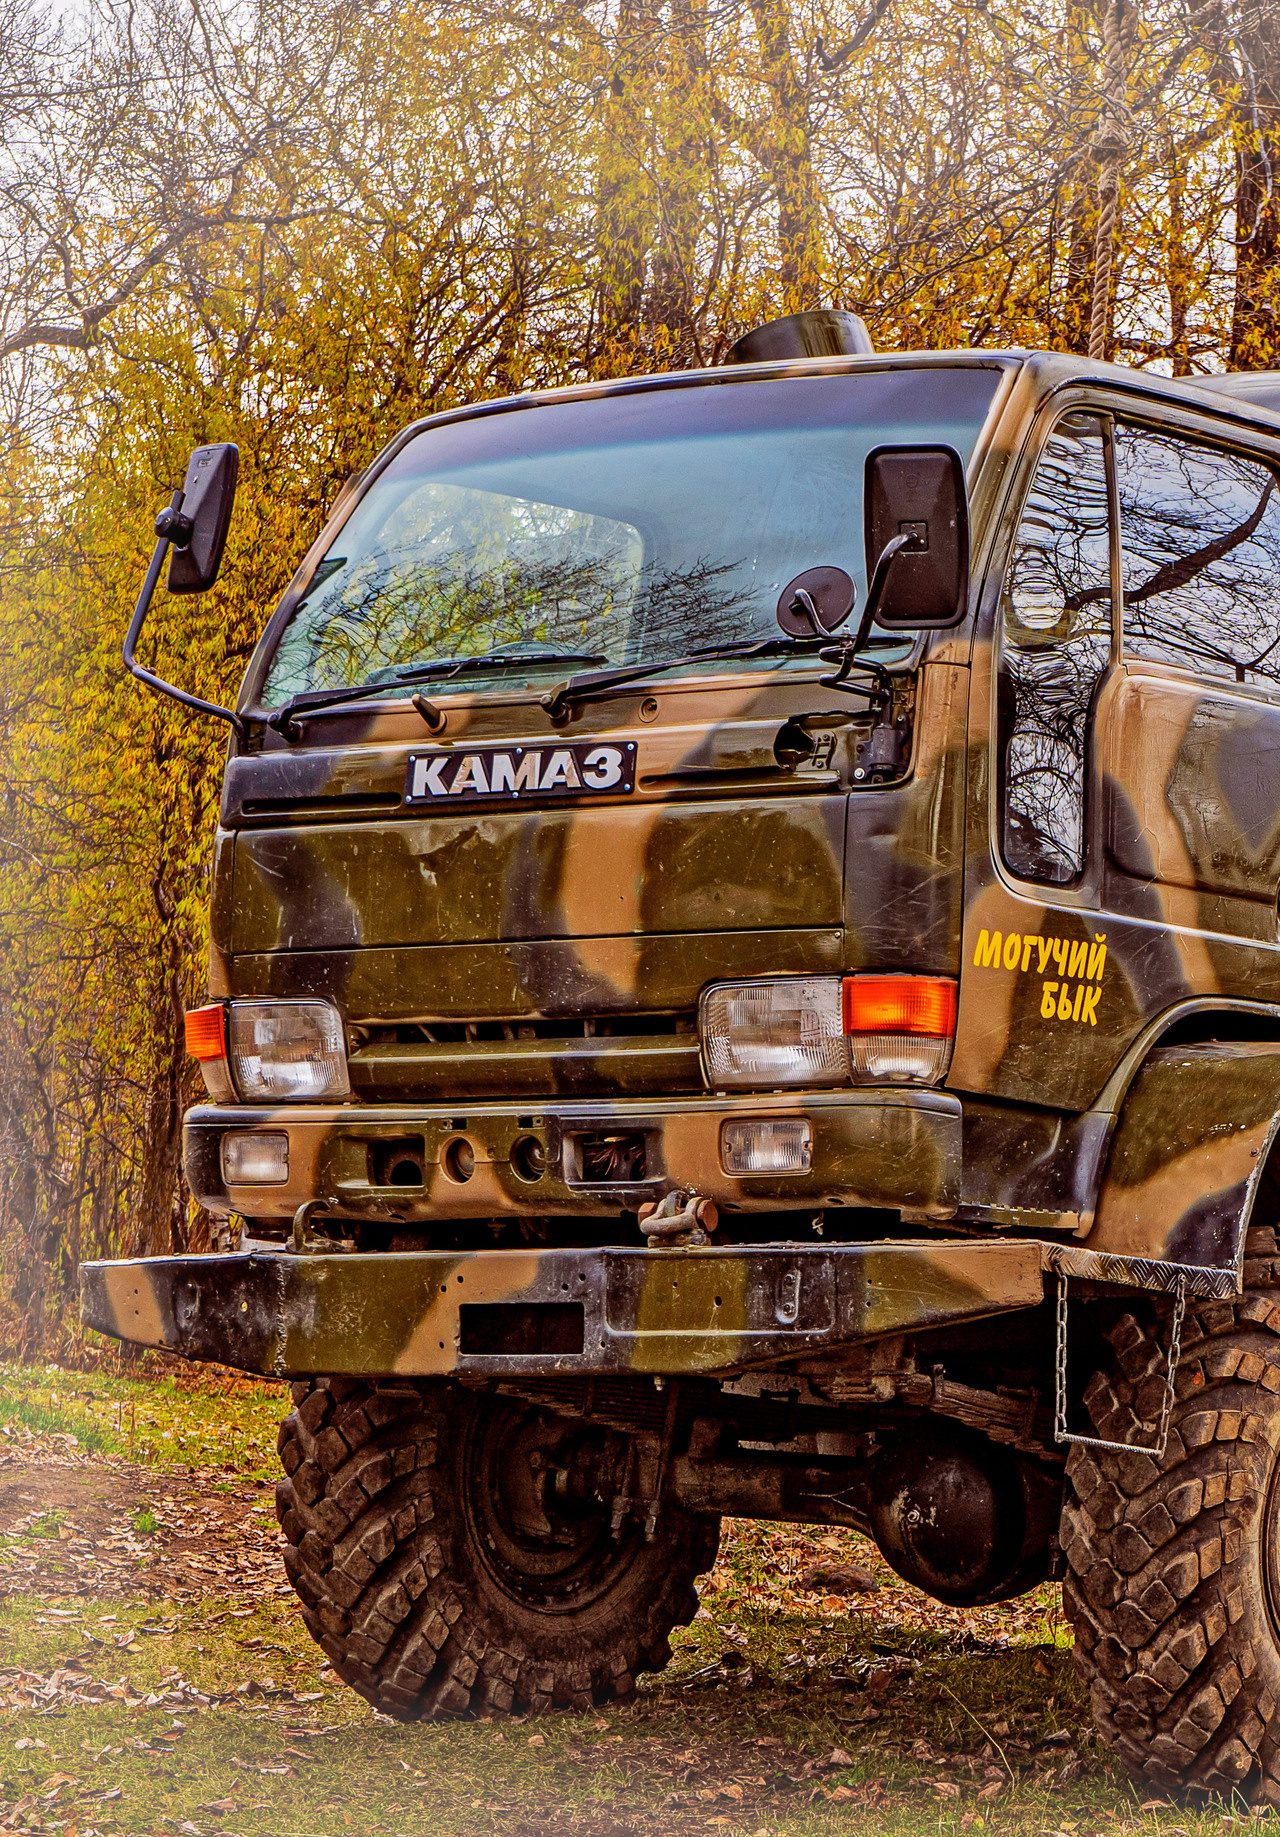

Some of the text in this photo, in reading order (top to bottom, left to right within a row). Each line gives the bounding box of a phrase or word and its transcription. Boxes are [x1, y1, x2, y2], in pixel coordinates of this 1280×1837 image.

[411, 747, 624, 798] КАМАЗ
[973, 928, 1108, 981] МОГУЧИЙ
[1040, 980, 1103, 1027] БЫК
